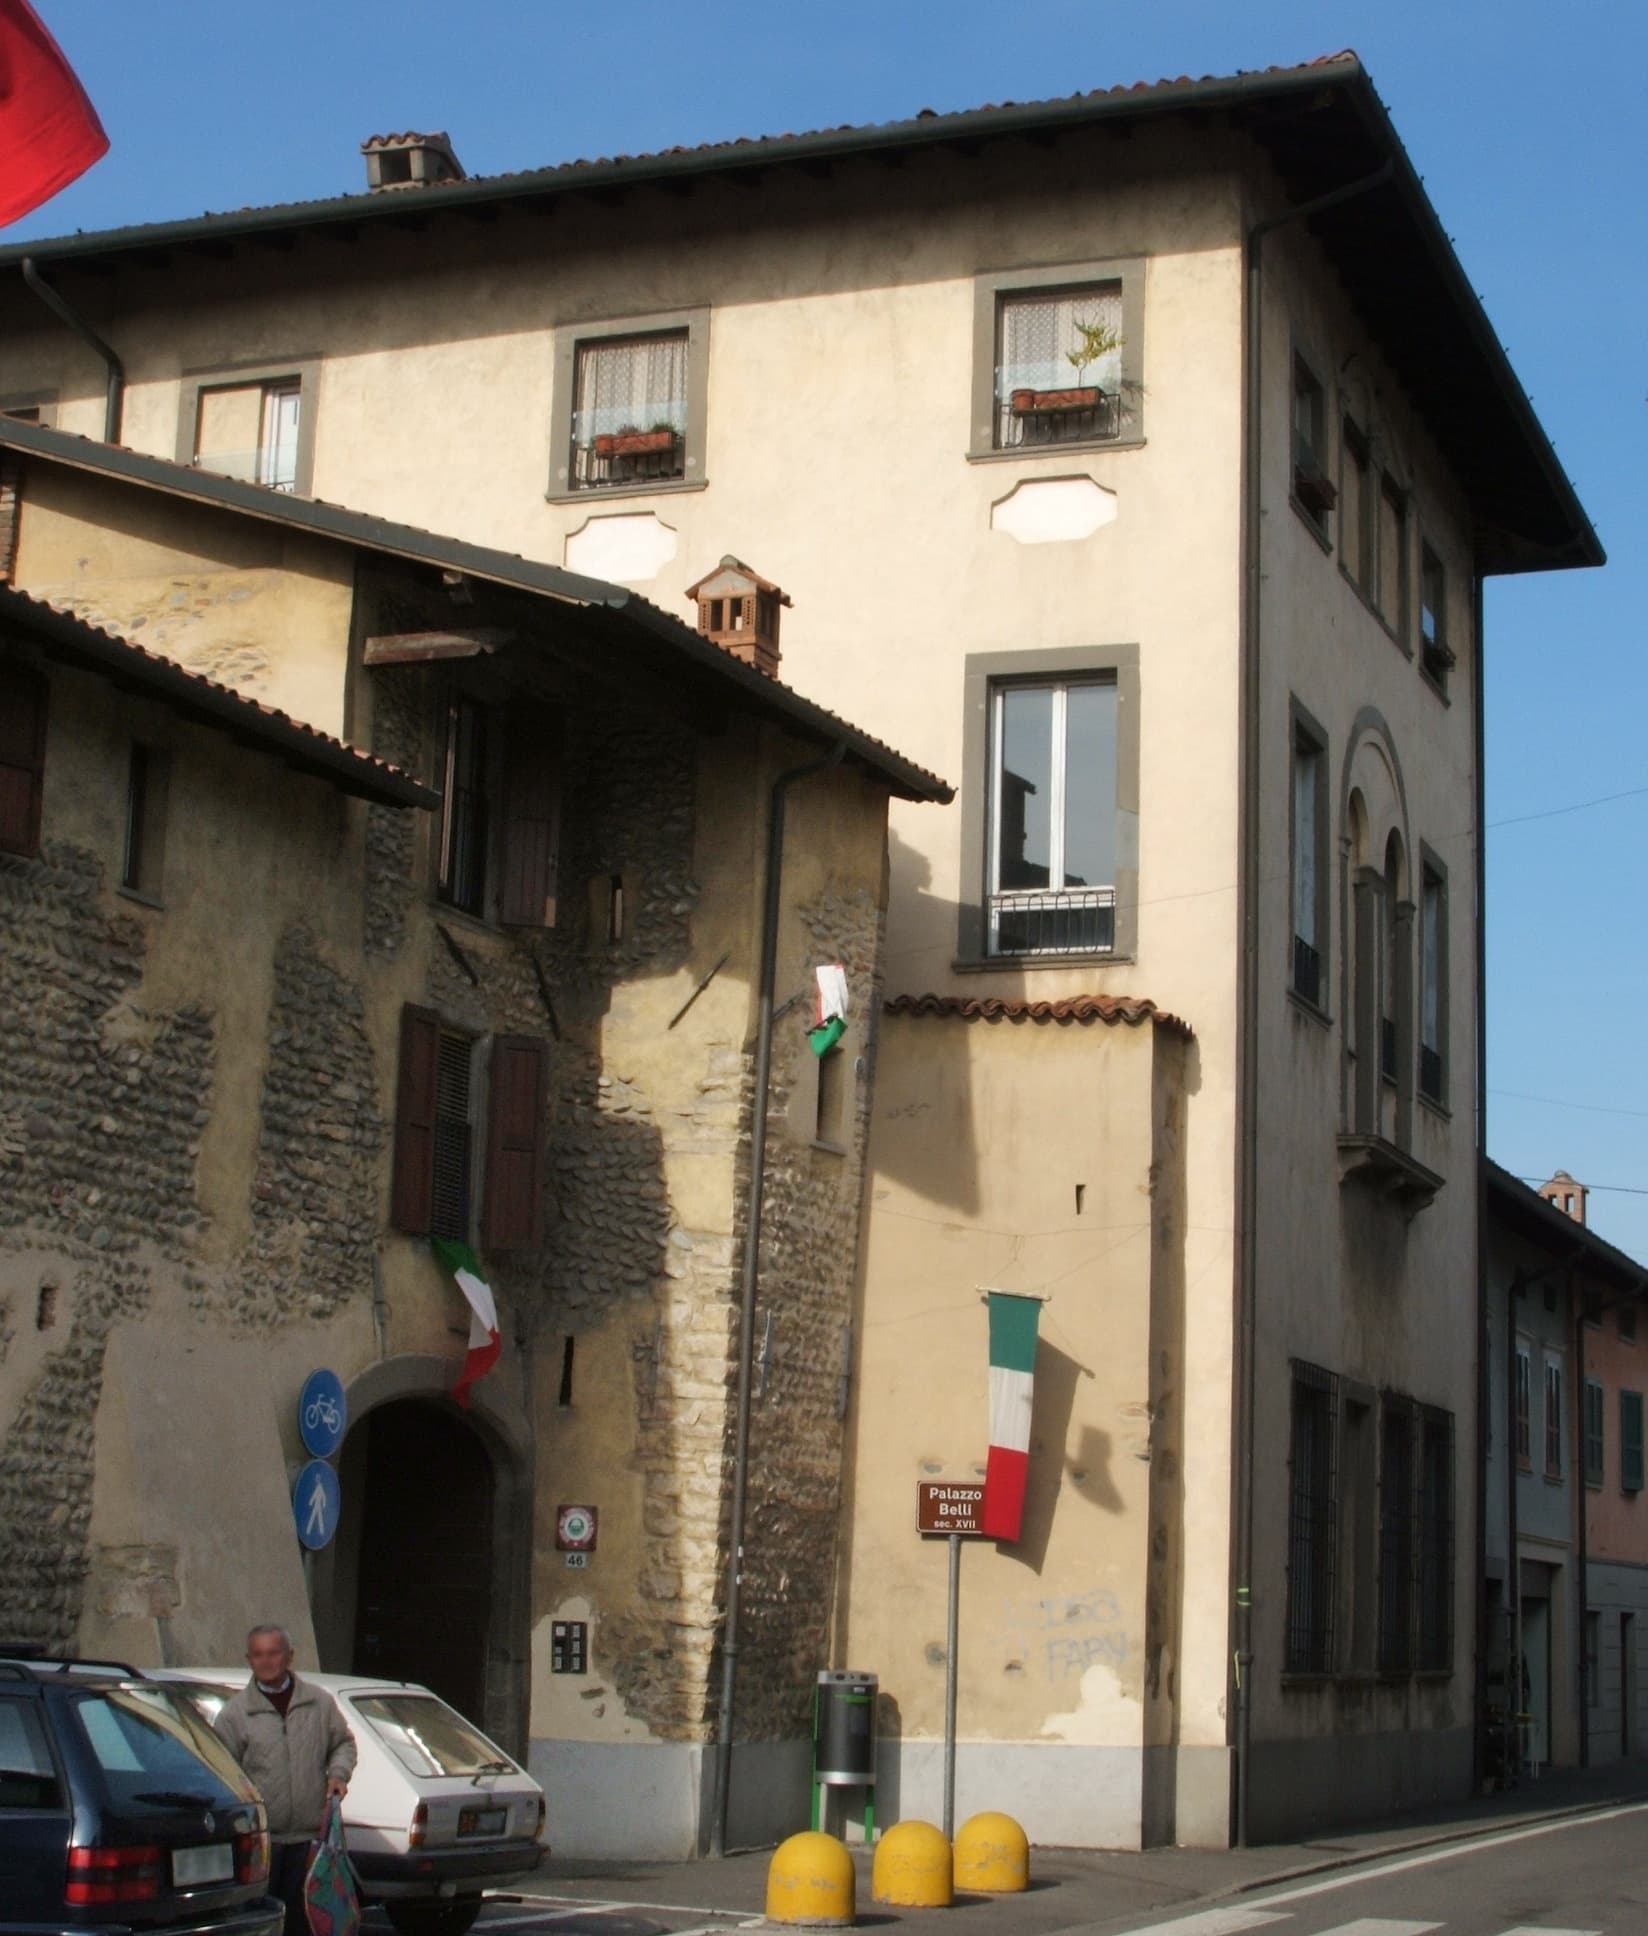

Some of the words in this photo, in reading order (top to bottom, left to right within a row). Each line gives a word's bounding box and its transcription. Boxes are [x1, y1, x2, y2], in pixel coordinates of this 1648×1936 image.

[929, 1487, 982, 1500] Palazzo
[939, 1503, 972, 1516] Belli
[934, 1520, 953, 1528] sec.
[955, 1519, 976, 1529] XVII
[568, 1554, 583, 1566] 46
